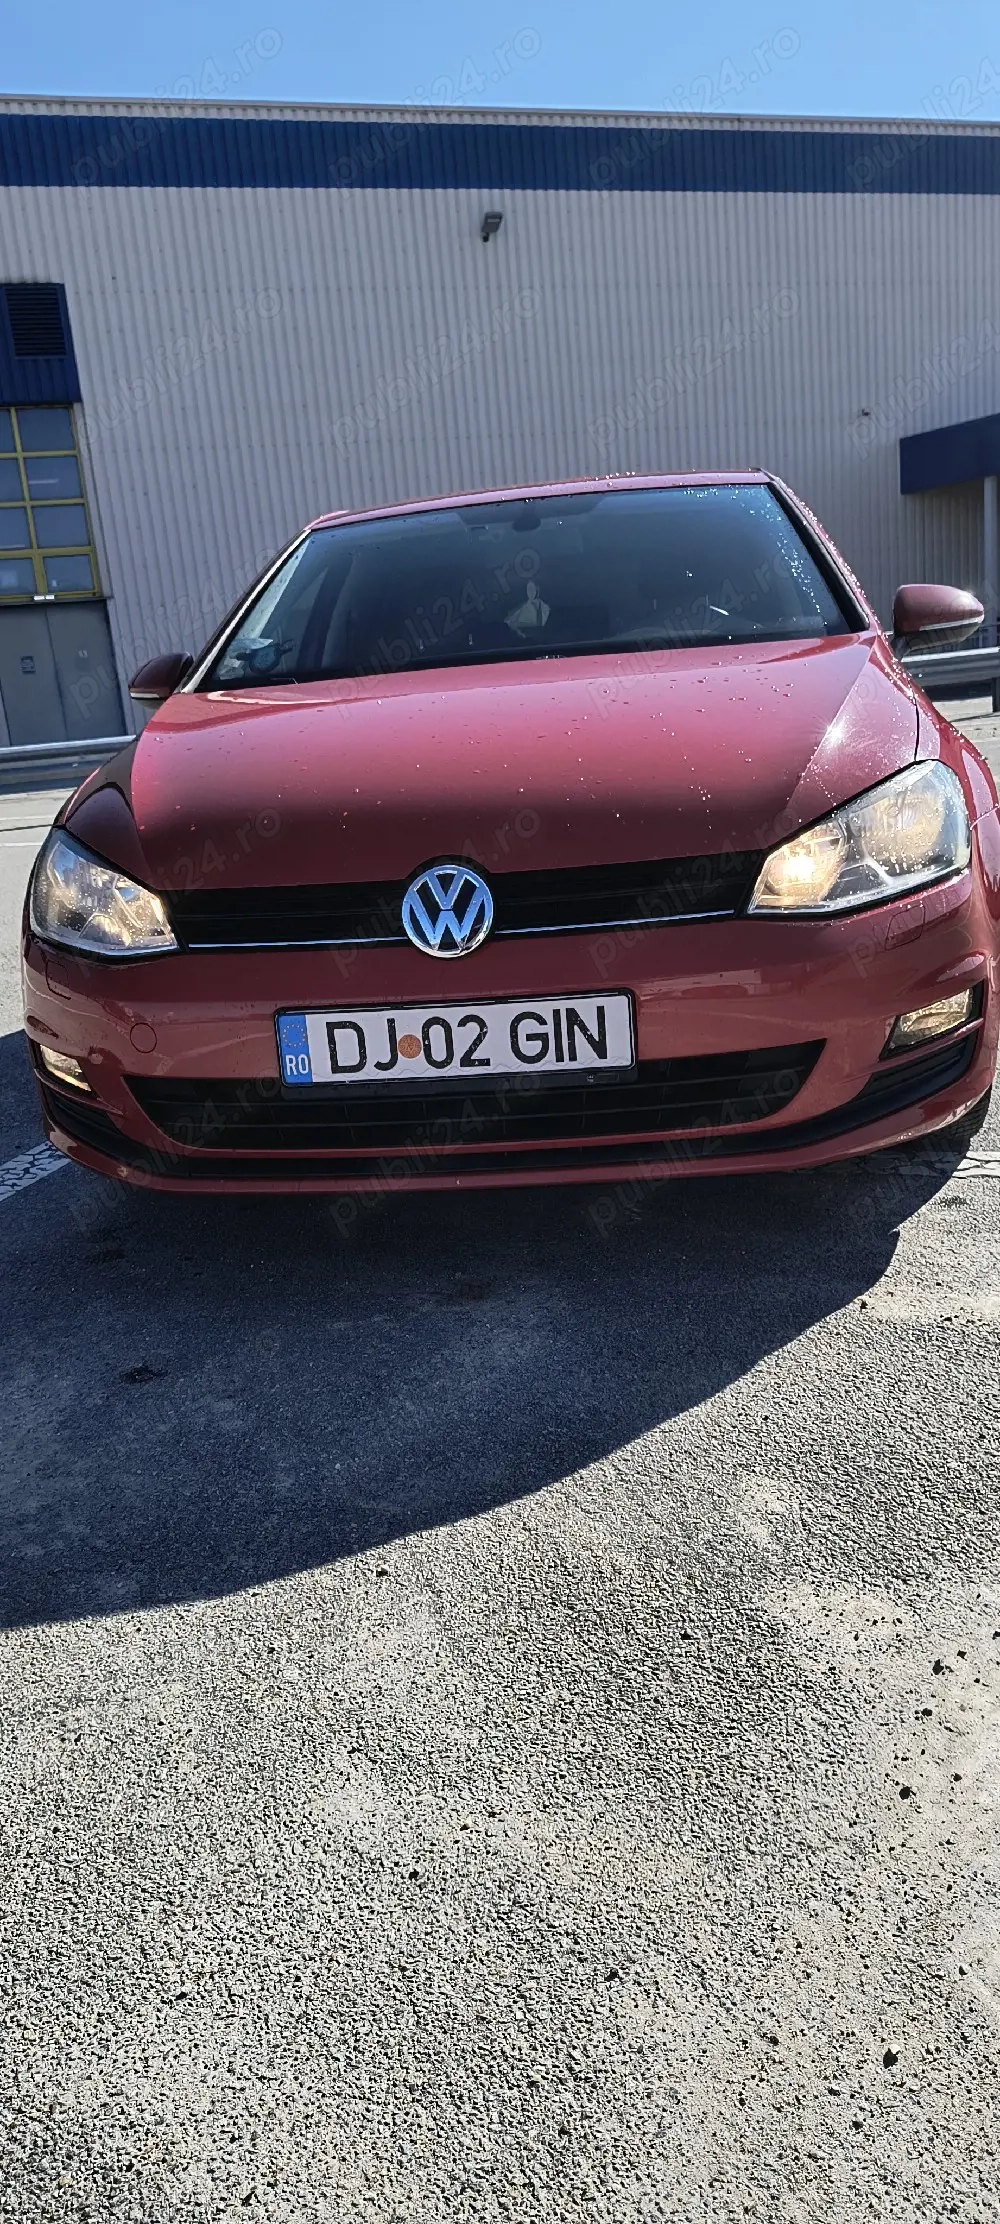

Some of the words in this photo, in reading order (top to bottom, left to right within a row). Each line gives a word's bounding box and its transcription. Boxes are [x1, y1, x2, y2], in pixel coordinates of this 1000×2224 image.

[326, 1018, 399, 1075] DJ
[423, 1014, 491, 1070] 02
[509, 1005, 608, 1064] GIN
[285, 1053, 310, 1077] RO
